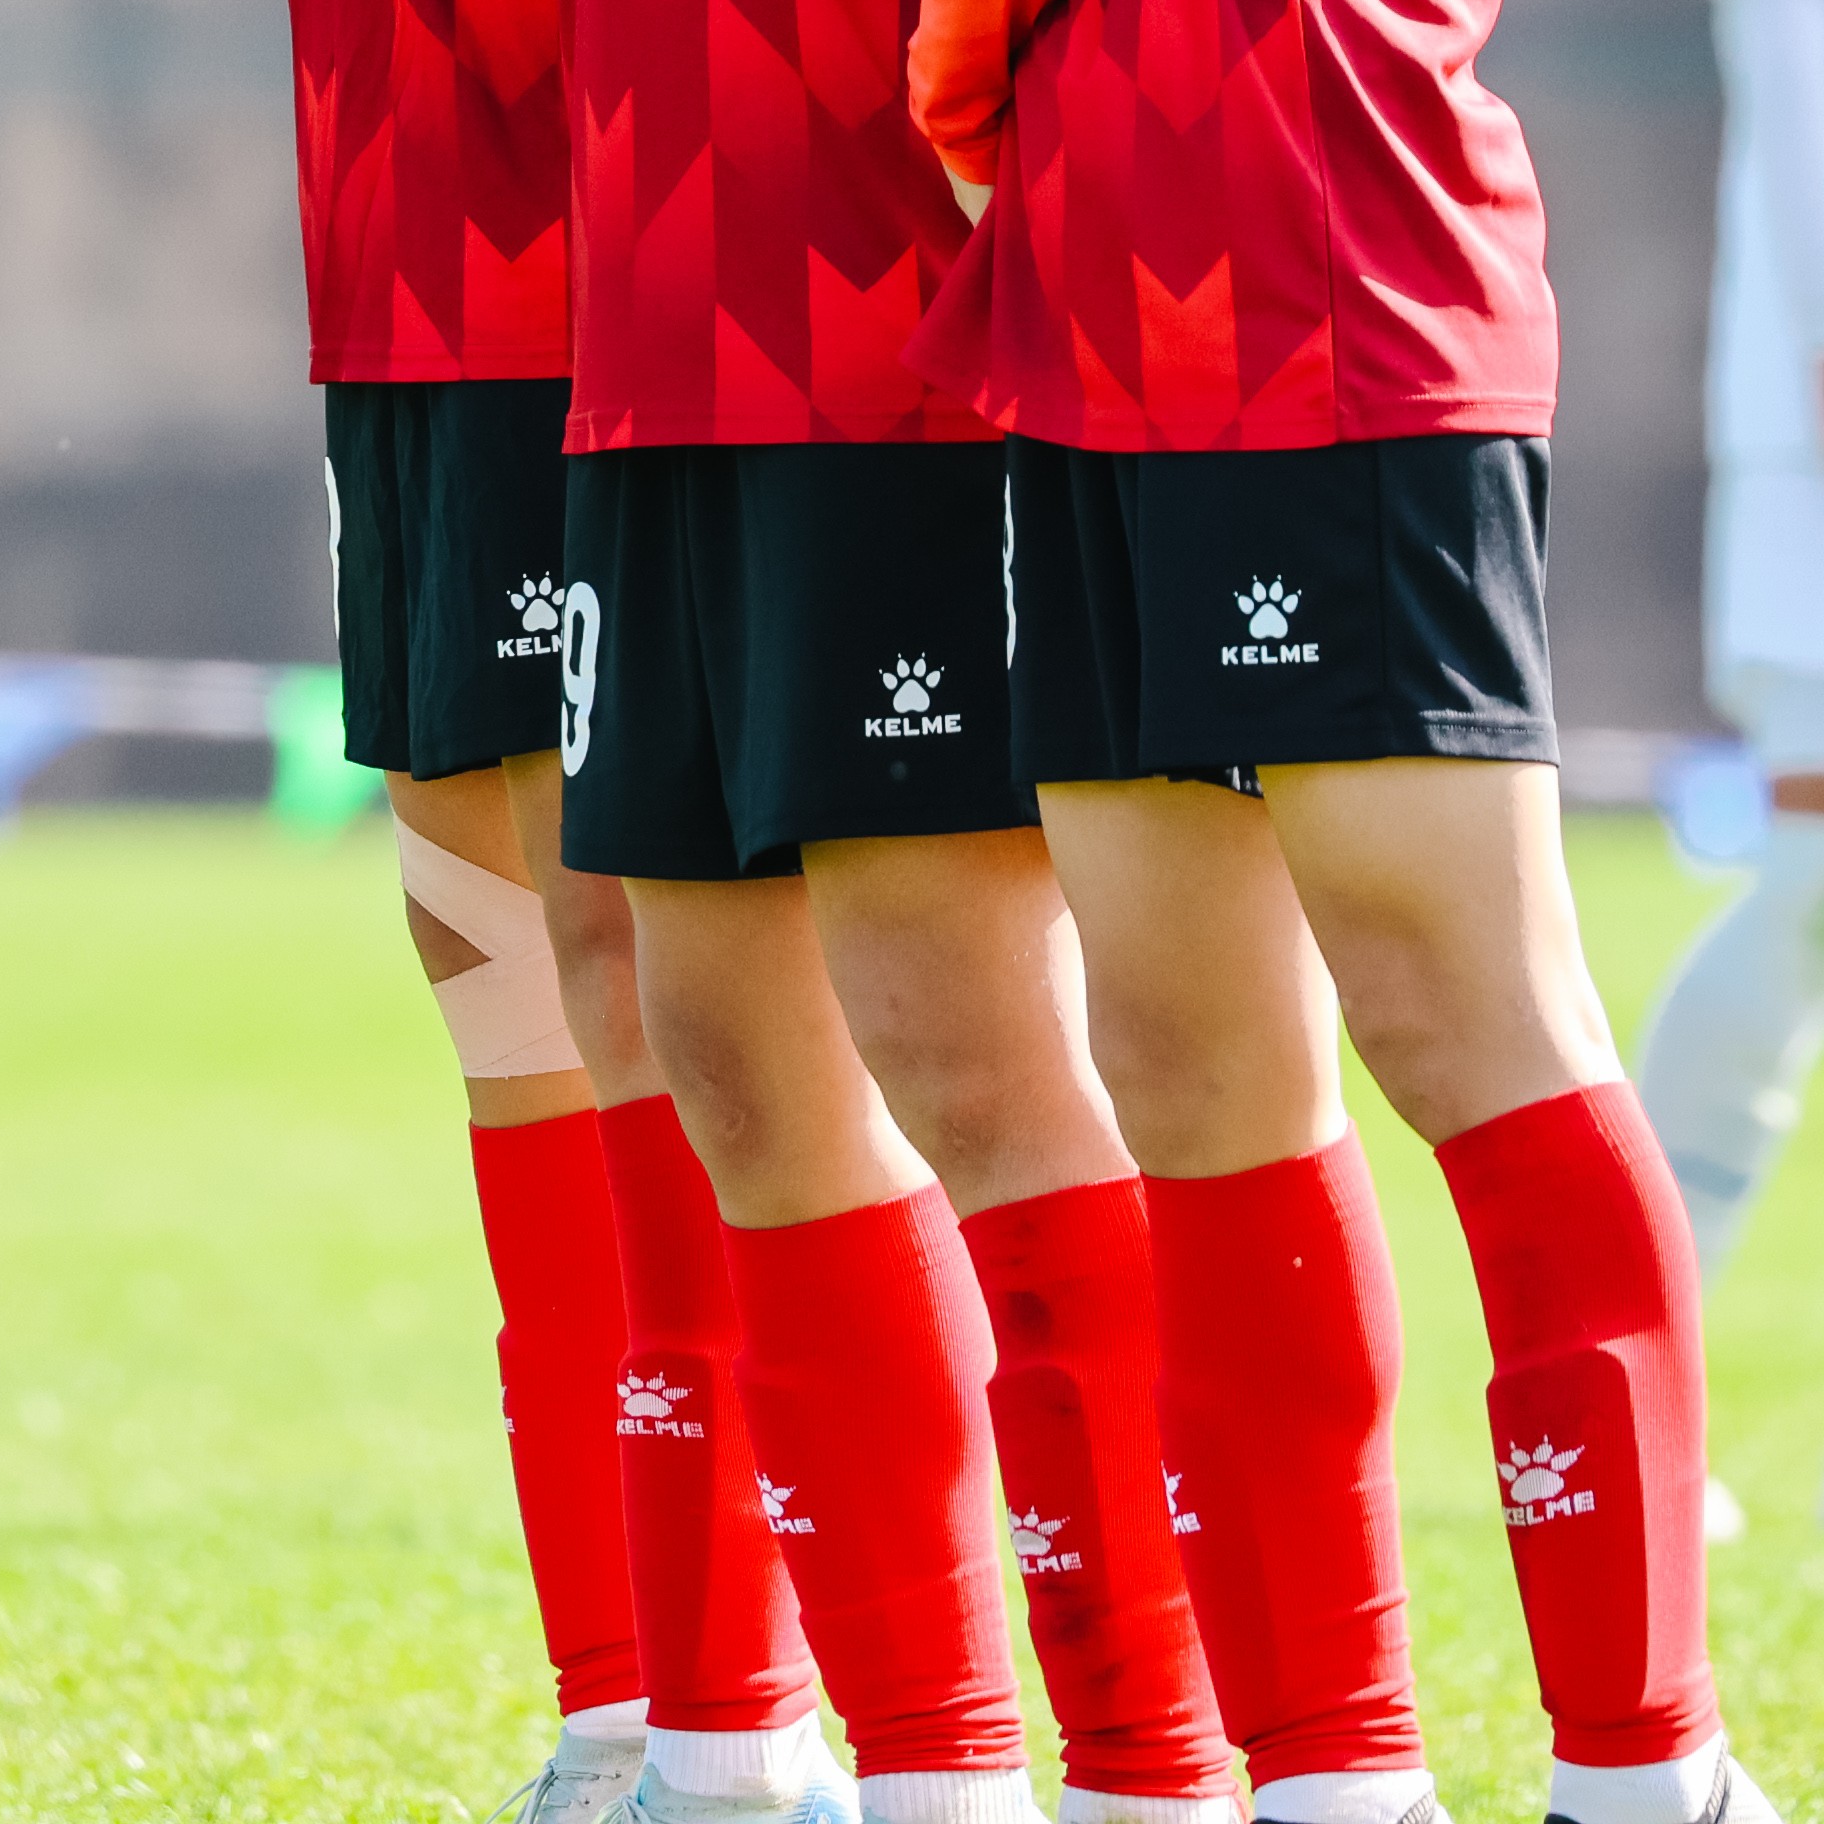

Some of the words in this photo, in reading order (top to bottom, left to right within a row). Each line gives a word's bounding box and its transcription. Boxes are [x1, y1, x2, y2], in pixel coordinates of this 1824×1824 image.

[497, 634, 563, 659] KELM
[1221, 642, 1320, 666] KELME
[561, 581, 601, 778] 9
[864, 713, 962, 738] KELME
[616, 1418, 705, 1438] KELME
[767, 1517, 816, 1534] LME
[1019, 1551, 1083, 1575] LME
